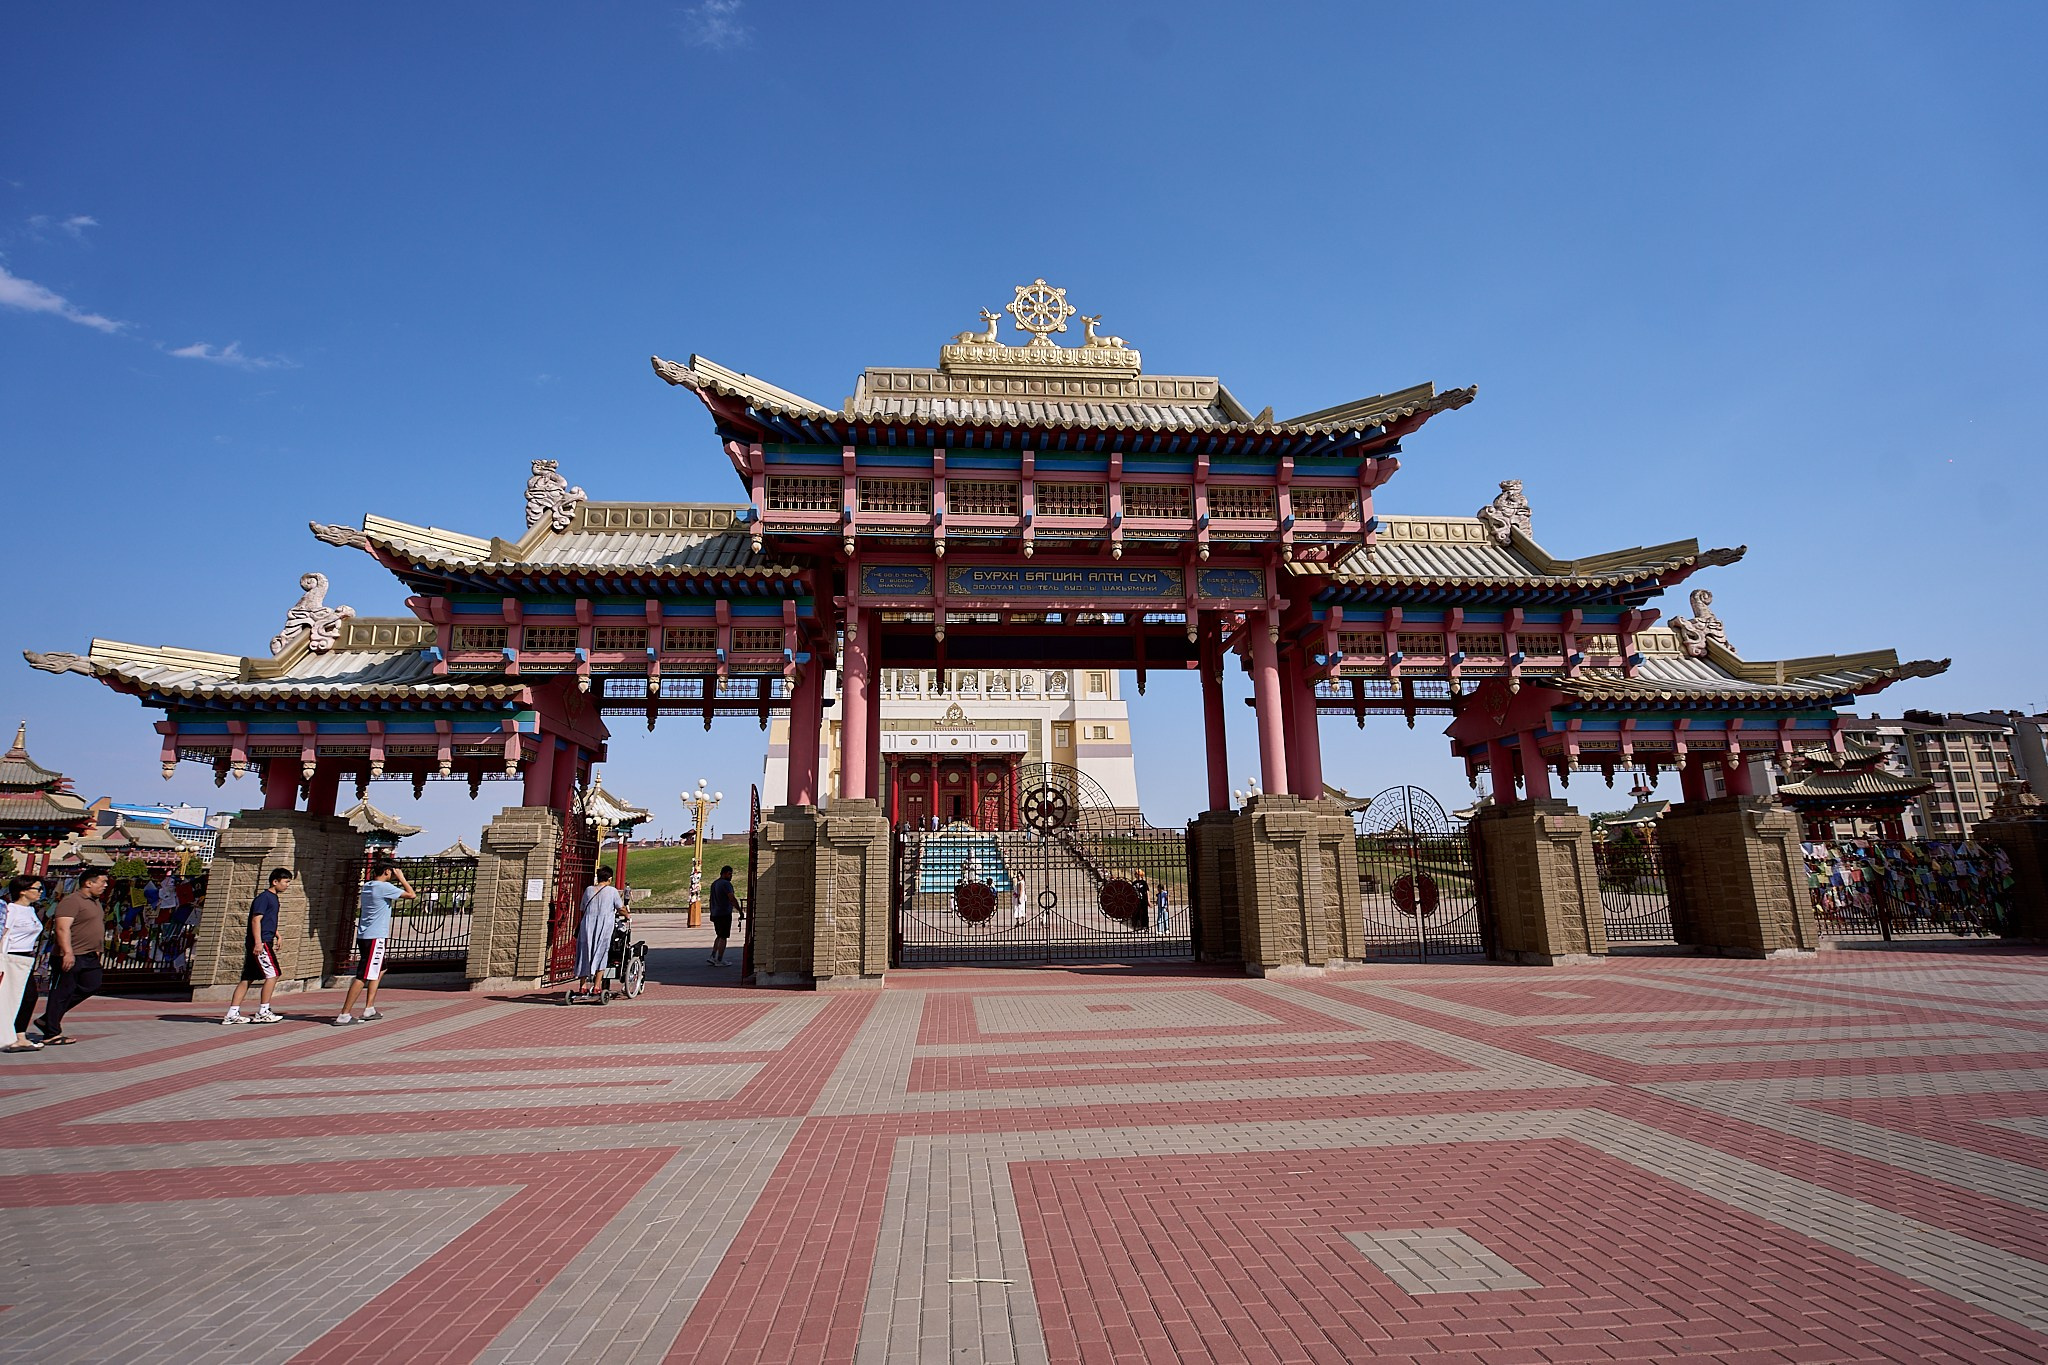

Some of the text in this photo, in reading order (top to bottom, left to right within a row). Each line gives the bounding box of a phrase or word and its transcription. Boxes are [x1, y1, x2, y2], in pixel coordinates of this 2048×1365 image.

[973, 571, 1019, 581] БУРХН
[1025, 572, 1082, 581] БАГШИН
[1088, 572, 1123, 582] АЛТН
